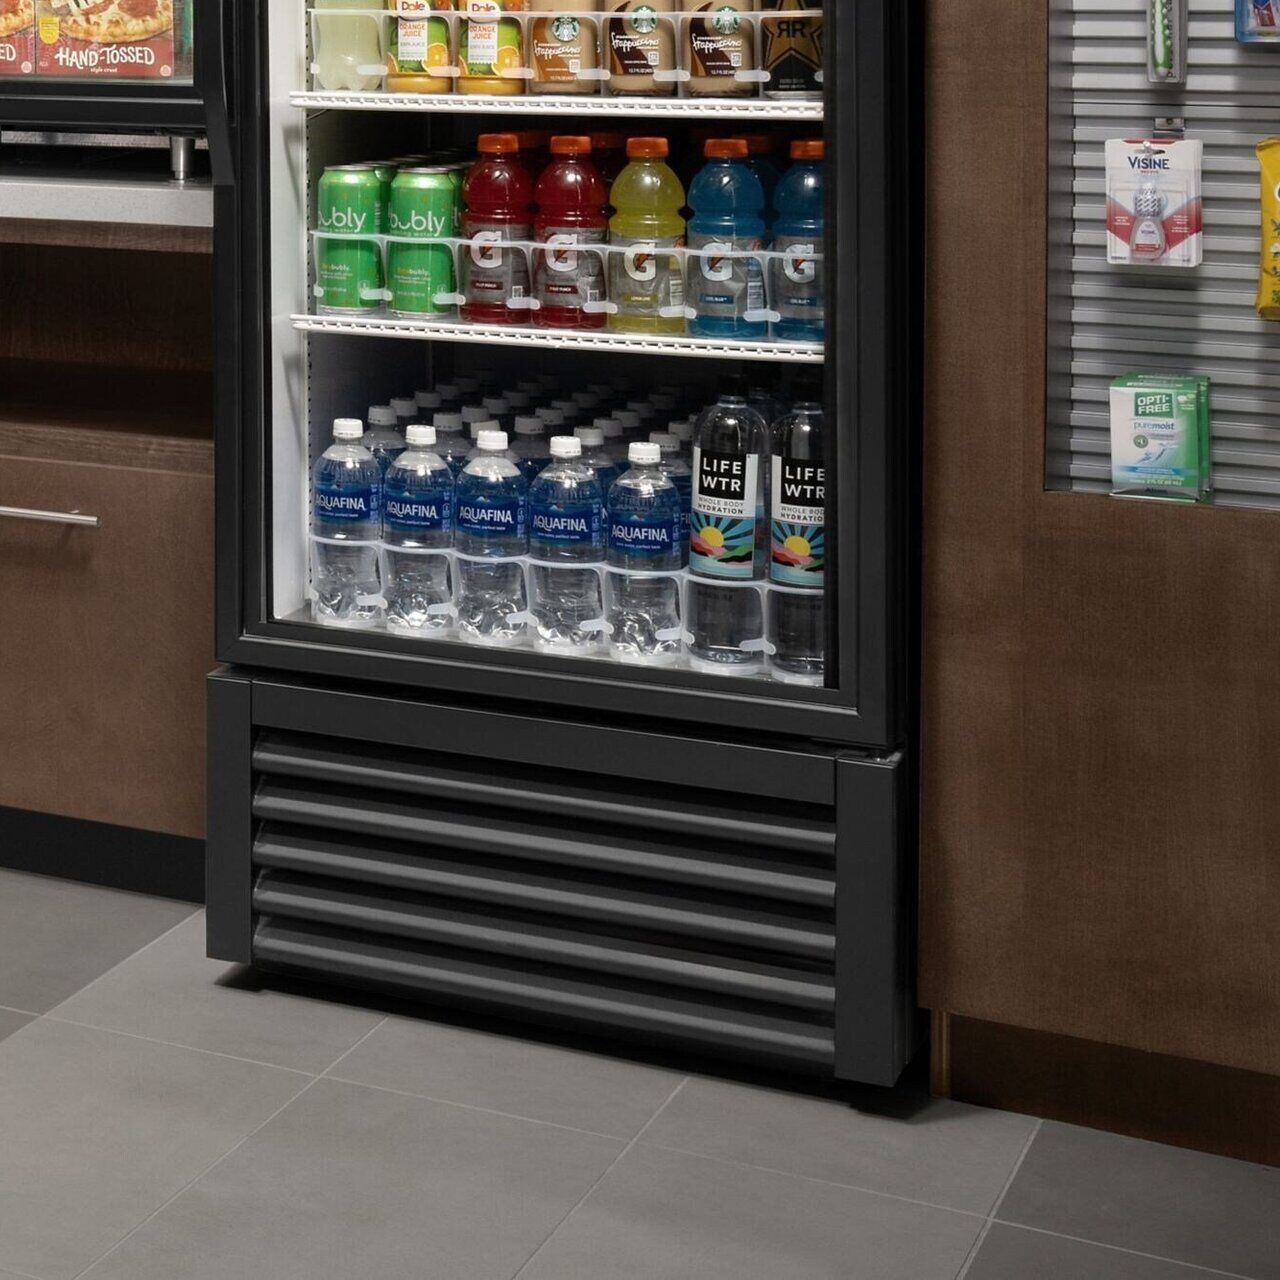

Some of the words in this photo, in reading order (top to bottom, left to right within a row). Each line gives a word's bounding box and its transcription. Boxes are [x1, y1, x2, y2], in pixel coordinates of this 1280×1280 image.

[401, 1, 425, 12] Dole
[399, 23, 425, 31] ORANGE
[403, 29, 422, 37] JUICE
[469, 25, 495, 33] ORANGE
[472, 32, 491, 40] JUICE
[54, 46, 155, 69] HAND-TOSSED
[1127, 156, 1170, 170] VISINE
[389, 210, 446, 237] bubly
[1138, 394, 1170, 406] OPTI-
[1138, 404, 1170, 415] FREE
[703, 457, 742, 475] LIFE
[784, 465, 825, 482] LIFE
[701, 475, 741, 492] WTR
[783, 482, 825, 499] WTR
[315, 497, 366, 511] AQUAFINA
[386, 502, 439, 519] AQUAFINA
[697, 504, 744, 515] HYDRATION
[460, 506, 514, 523] AQUAFINA
[533, 514, 588, 534] AQUAFINA
[611, 524, 669, 543] AQUAFINA
